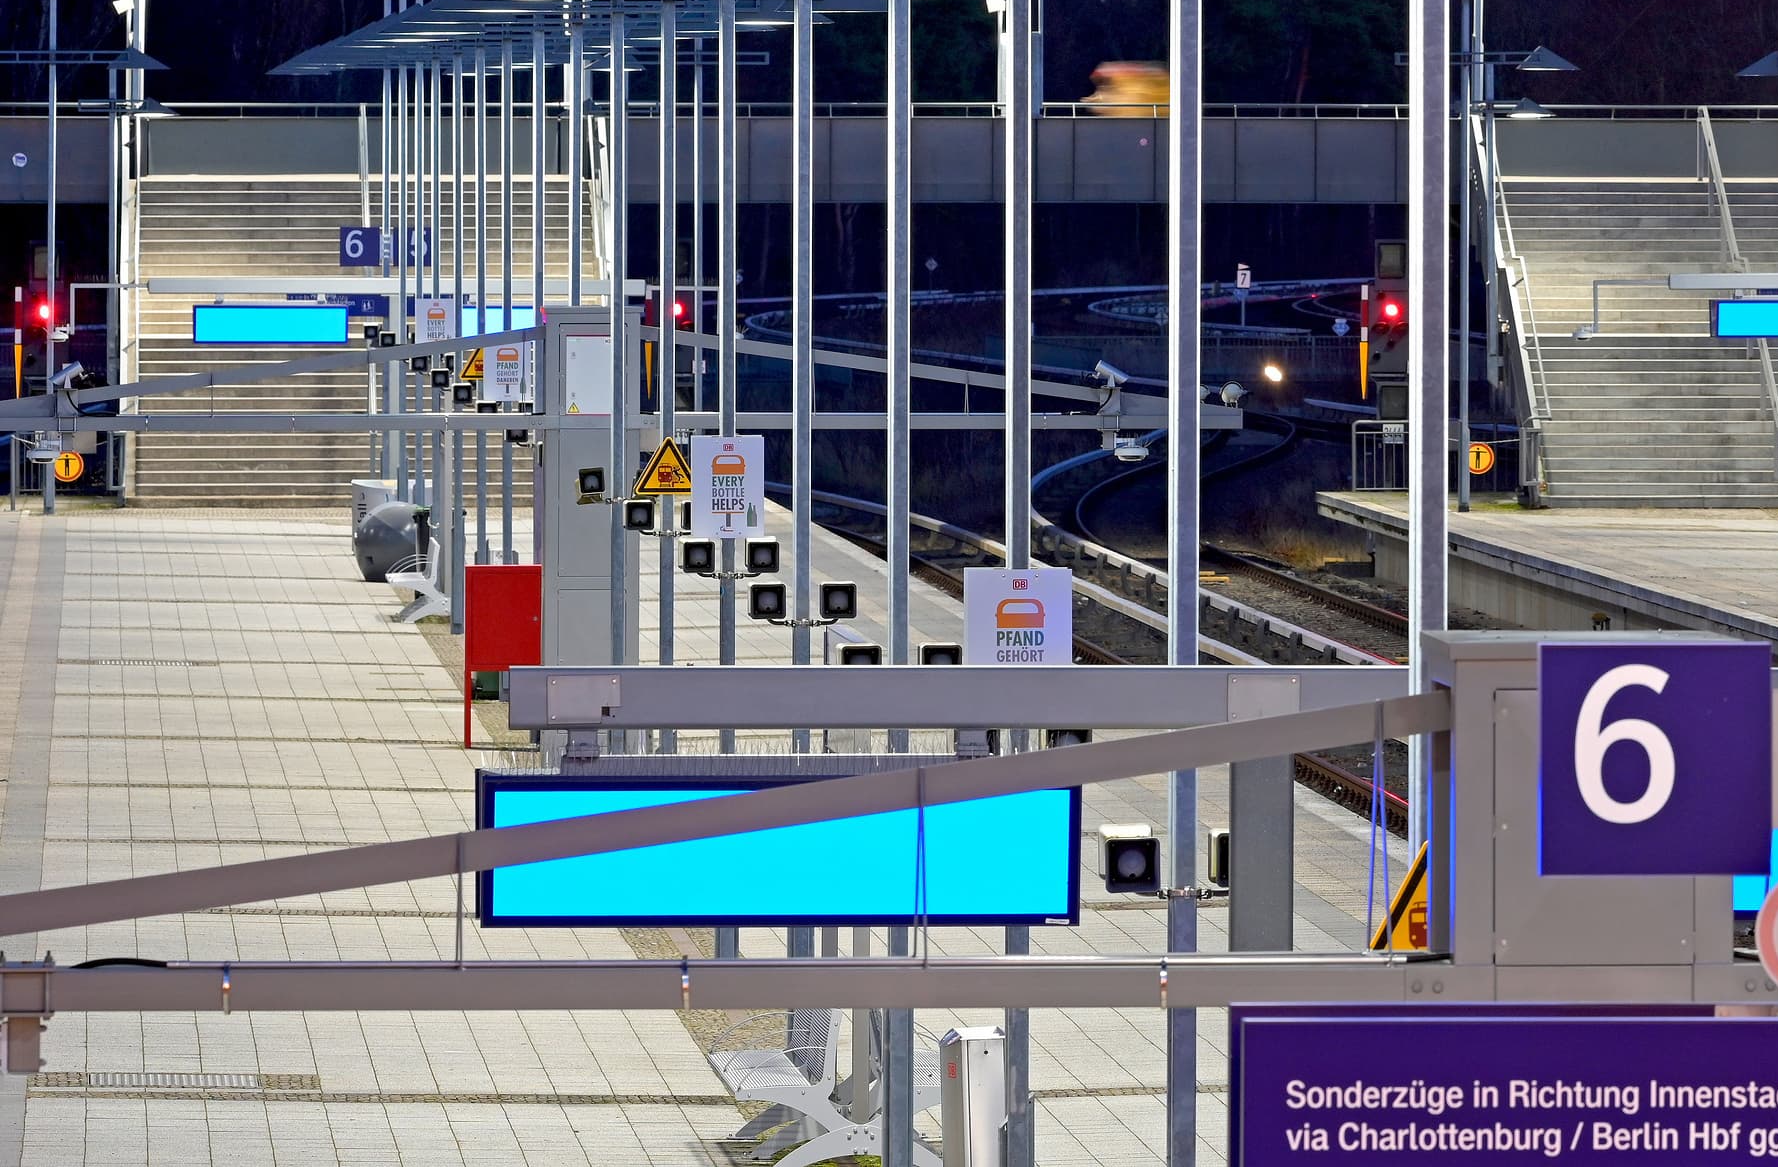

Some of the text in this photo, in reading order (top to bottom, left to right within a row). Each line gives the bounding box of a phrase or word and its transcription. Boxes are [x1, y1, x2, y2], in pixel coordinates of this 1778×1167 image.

[345, 230, 364, 258] 6
[1241, 272, 1247, 286] 7
[712, 476, 745, 487] EVERY
[712, 487, 745, 498] BOTTLE
[712, 498, 745, 511] HELPS
[1013, 579, 1028, 590] DB
[997, 631, 1045, 646] PFAND
[997, 647, 1045, 662] GEHÖRT
[1574, 663, 1676, 825] 6
[1286, 1079, 1464, 1113] Sonderzüge
[1473, 1079, 1499, 1108] in
[1509, 1079, 1640, 1113] Richtung
[1286, 1122, 1330, 1151] via
[1338, 1121, 1562, 1157] Charlottenburg
[1570, 1121, 1584, 1151] /
[1592, 1121, 1679, 1151] Berlin
[1689, 1121, 1742, 1151] Hbf
